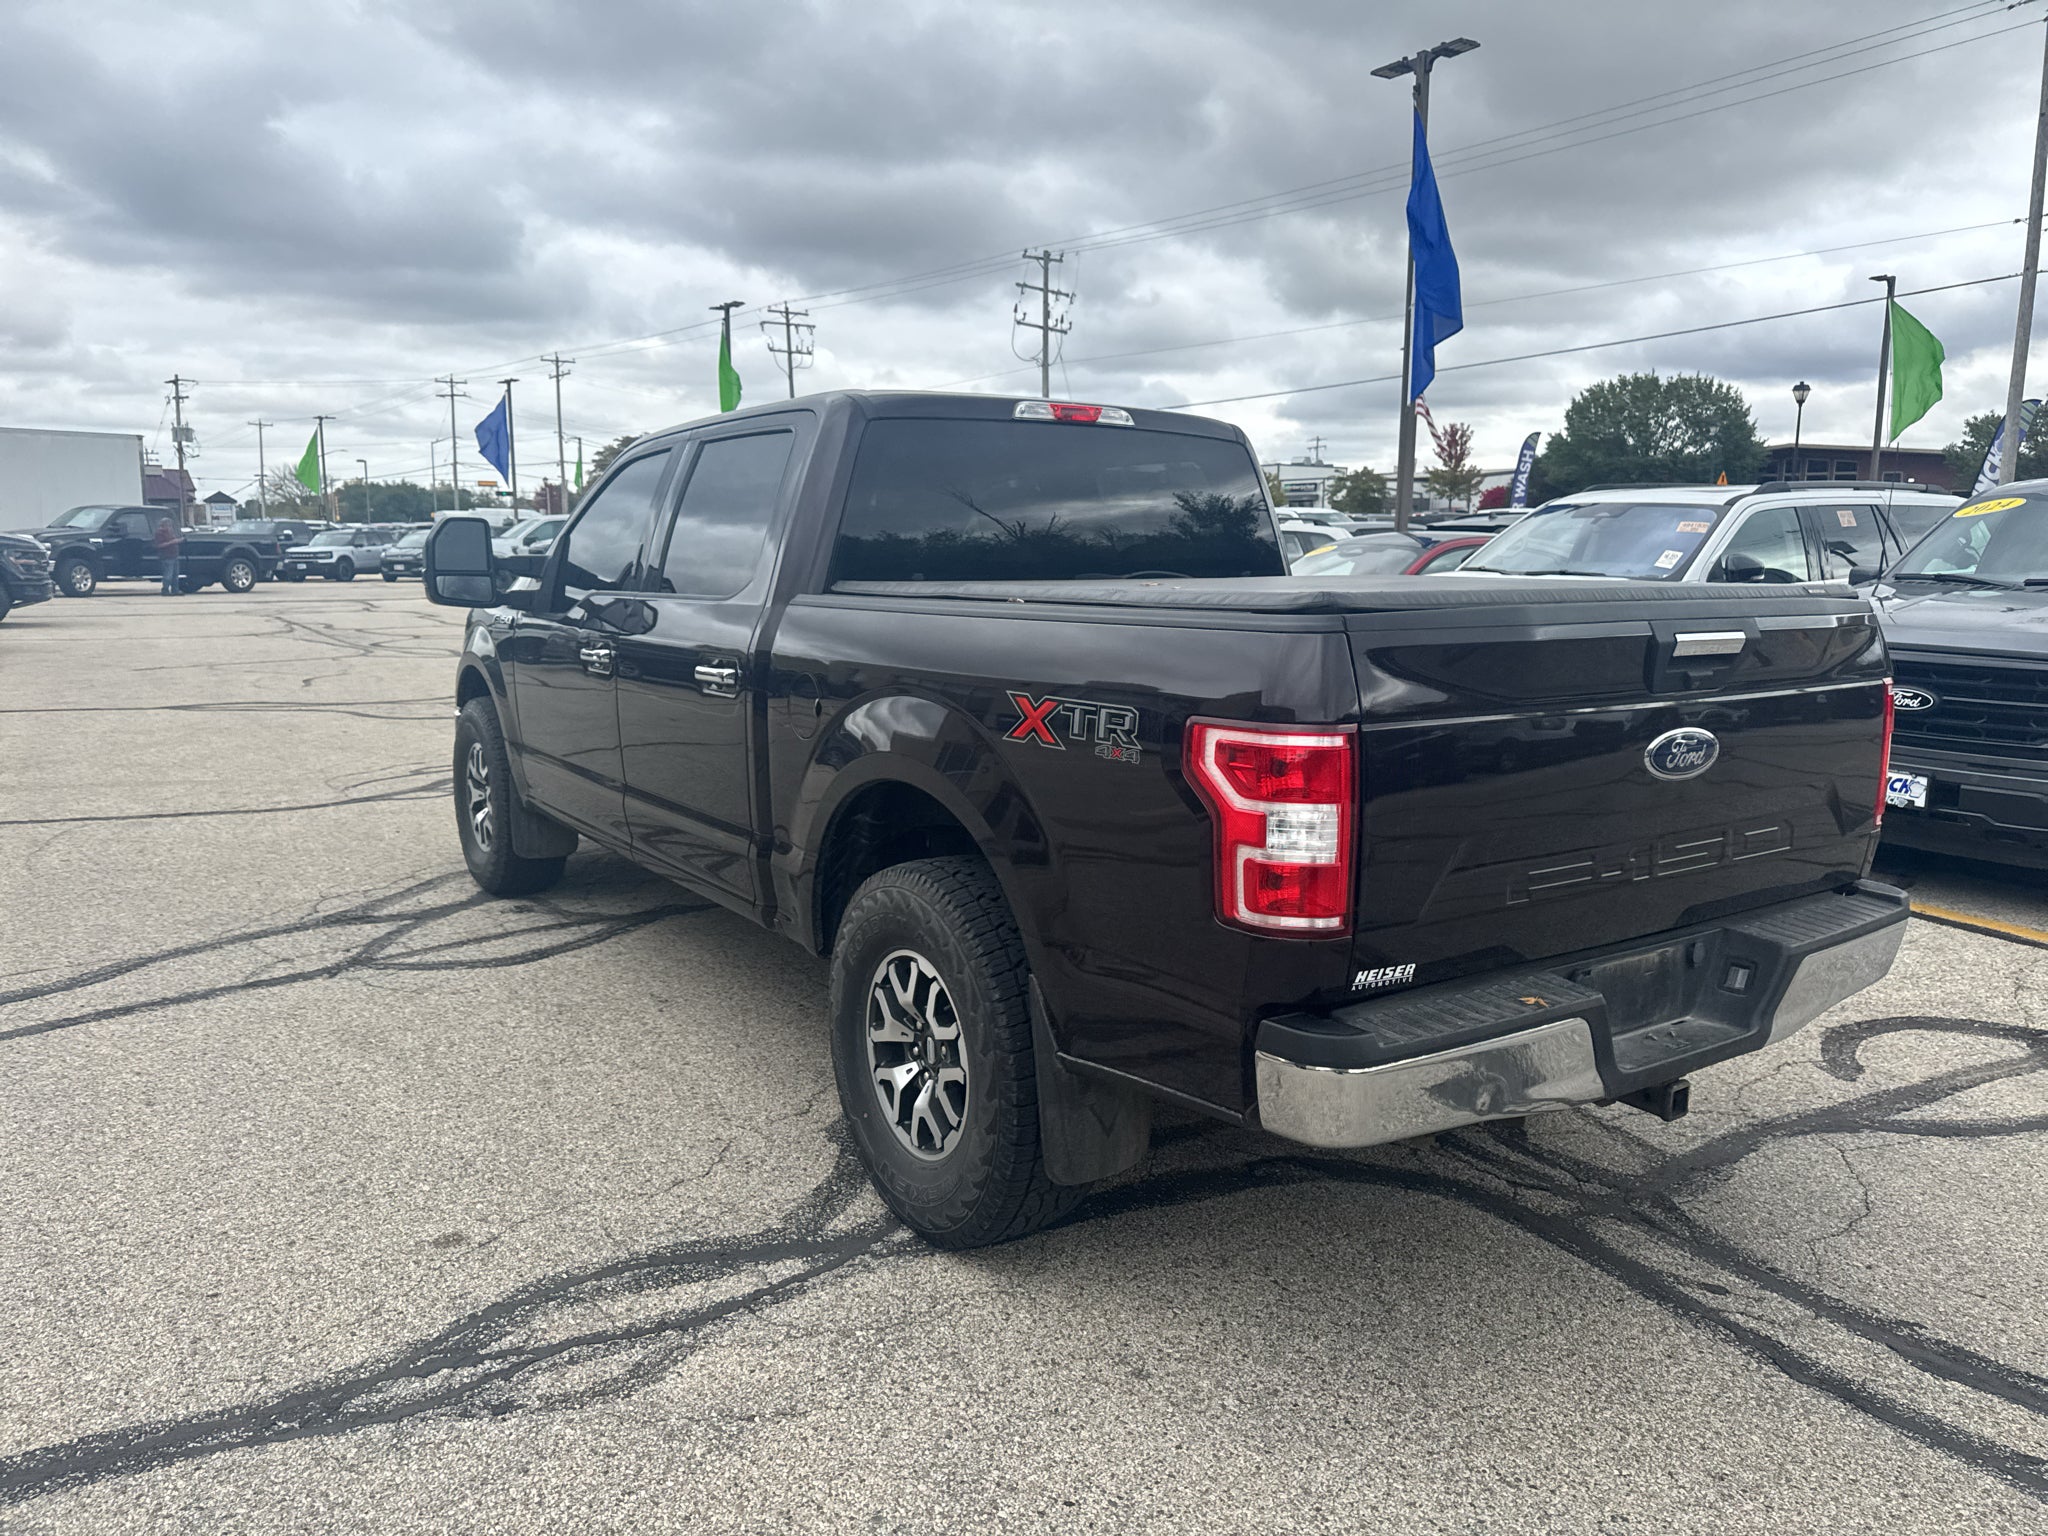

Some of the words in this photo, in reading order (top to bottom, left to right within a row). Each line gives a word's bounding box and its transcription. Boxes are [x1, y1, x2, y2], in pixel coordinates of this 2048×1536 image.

[1515, 450, 1534, 497] WASH
[1962, 499, 2018, 515] 2024
[1894, 691, 1922, 708] Ford
[1002, 690, 1143, 751] XTR
[1666, 738, 1707, 769] Ford
[1506, 819, 1794, 905] F-150
[1351, 976, 1413, 991] AUTOMOTIVE
[1354, 963, 1416, 983] HEISER
